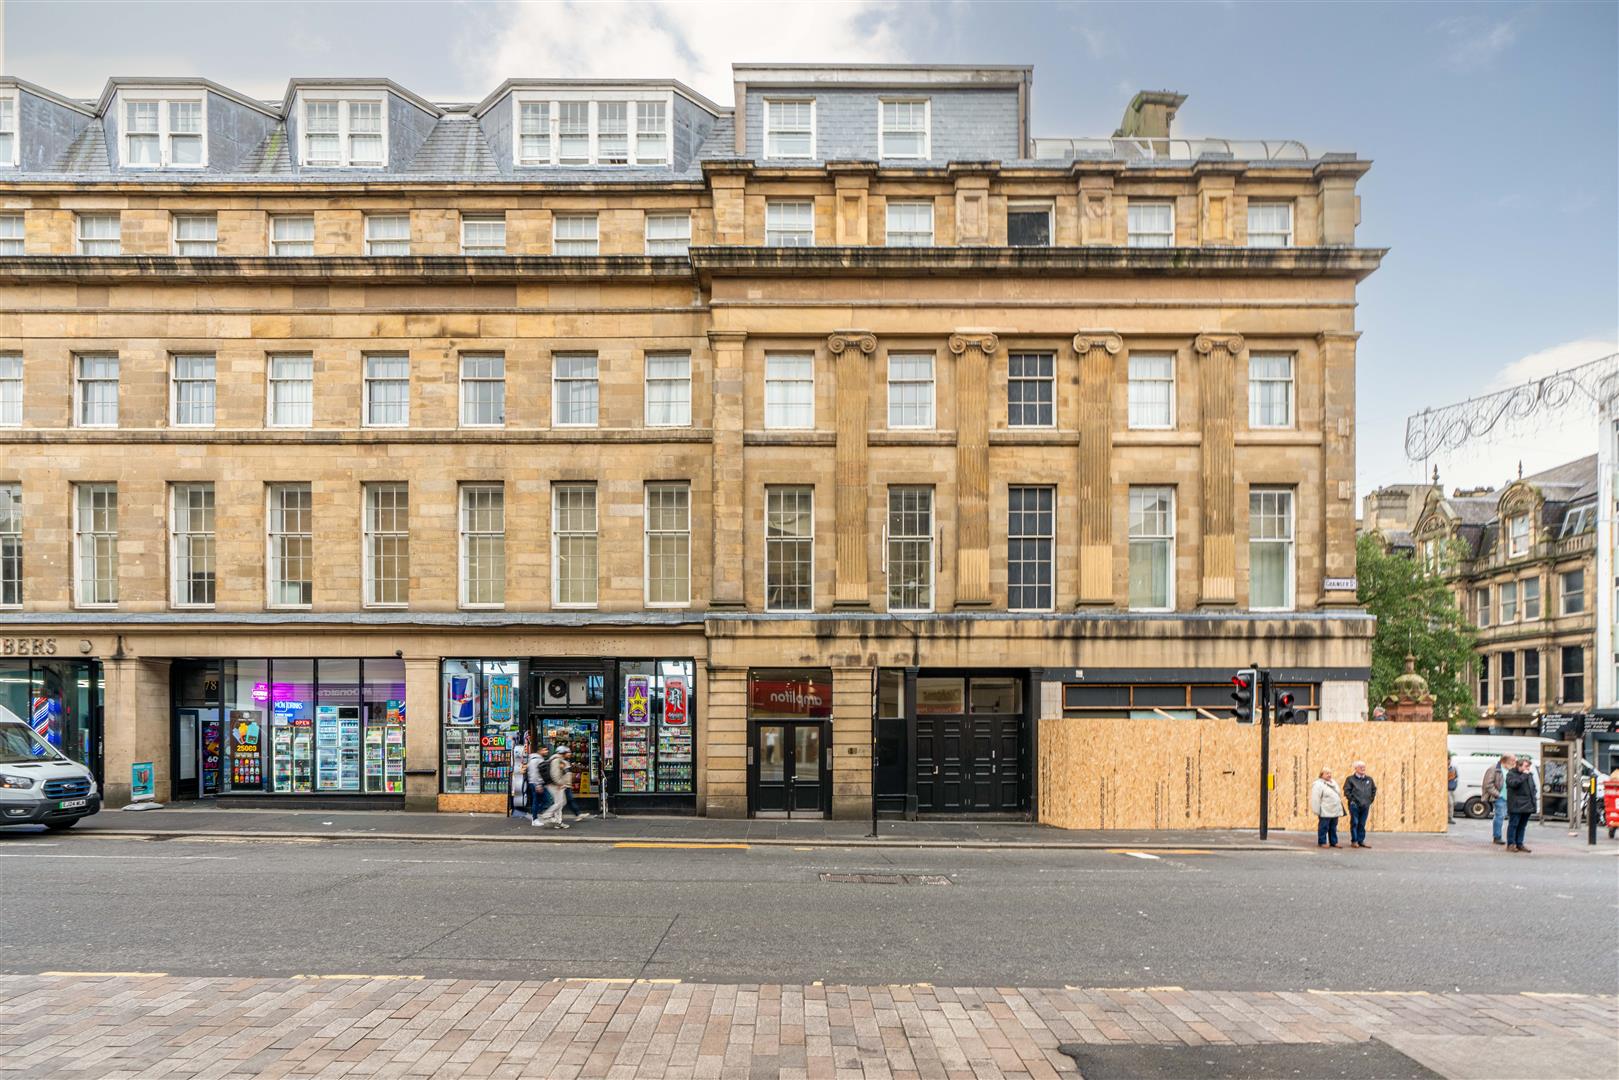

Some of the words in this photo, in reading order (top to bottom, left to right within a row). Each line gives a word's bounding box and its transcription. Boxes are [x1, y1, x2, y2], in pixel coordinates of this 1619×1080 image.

[0, 638, 57, 655] BERS
[205, 680, 217, 691] 78
[481, 736, 505, 747] OPEN
